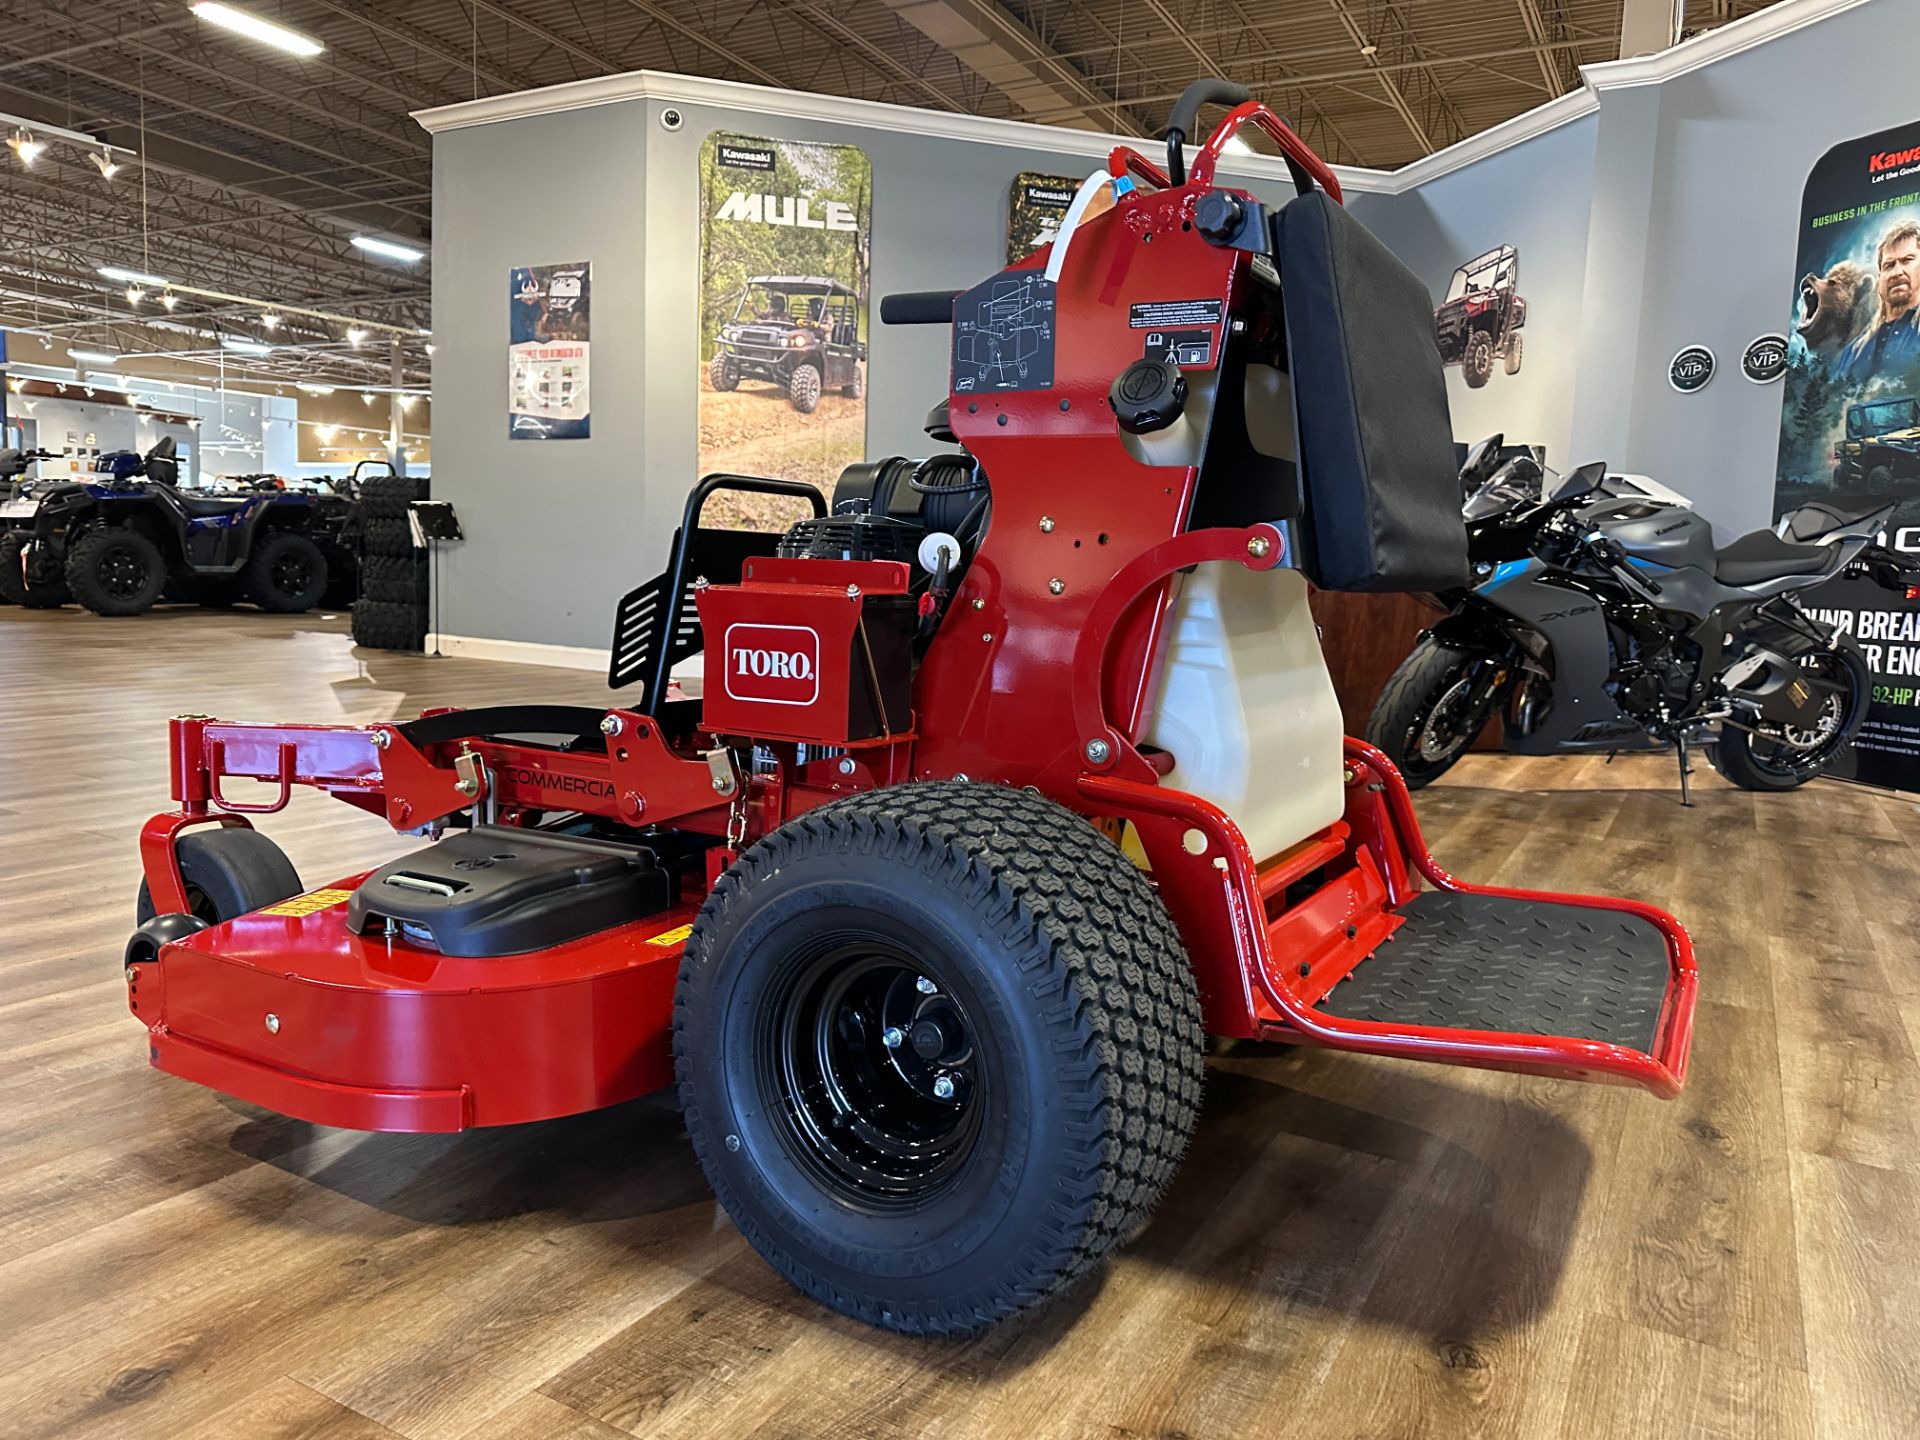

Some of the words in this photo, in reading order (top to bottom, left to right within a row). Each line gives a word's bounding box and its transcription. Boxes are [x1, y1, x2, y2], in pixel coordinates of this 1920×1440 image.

[722, 148, 771, 163] Kawasaki
[1871, 174, 1884, 184] Let
[1885, 171, 1898, 180] the
[1029, 188, 1071, 201] Kawasaki
[714, 191, 858, 231] MULE
[1812, 209, 1855, 228] BUSINESS
[1857, 206, 1867, 217] IN
[1869, 200, 1887, 213] THE
[1752, 354, 1779, 367] VIP
[1679, 364, 1702, 377] VIP
[1654, 518, 1692, 537] Kawasaki
[1872, 685, 1914, 706] 92-HP
[506, 767, 617, 799] COMMERCIA
